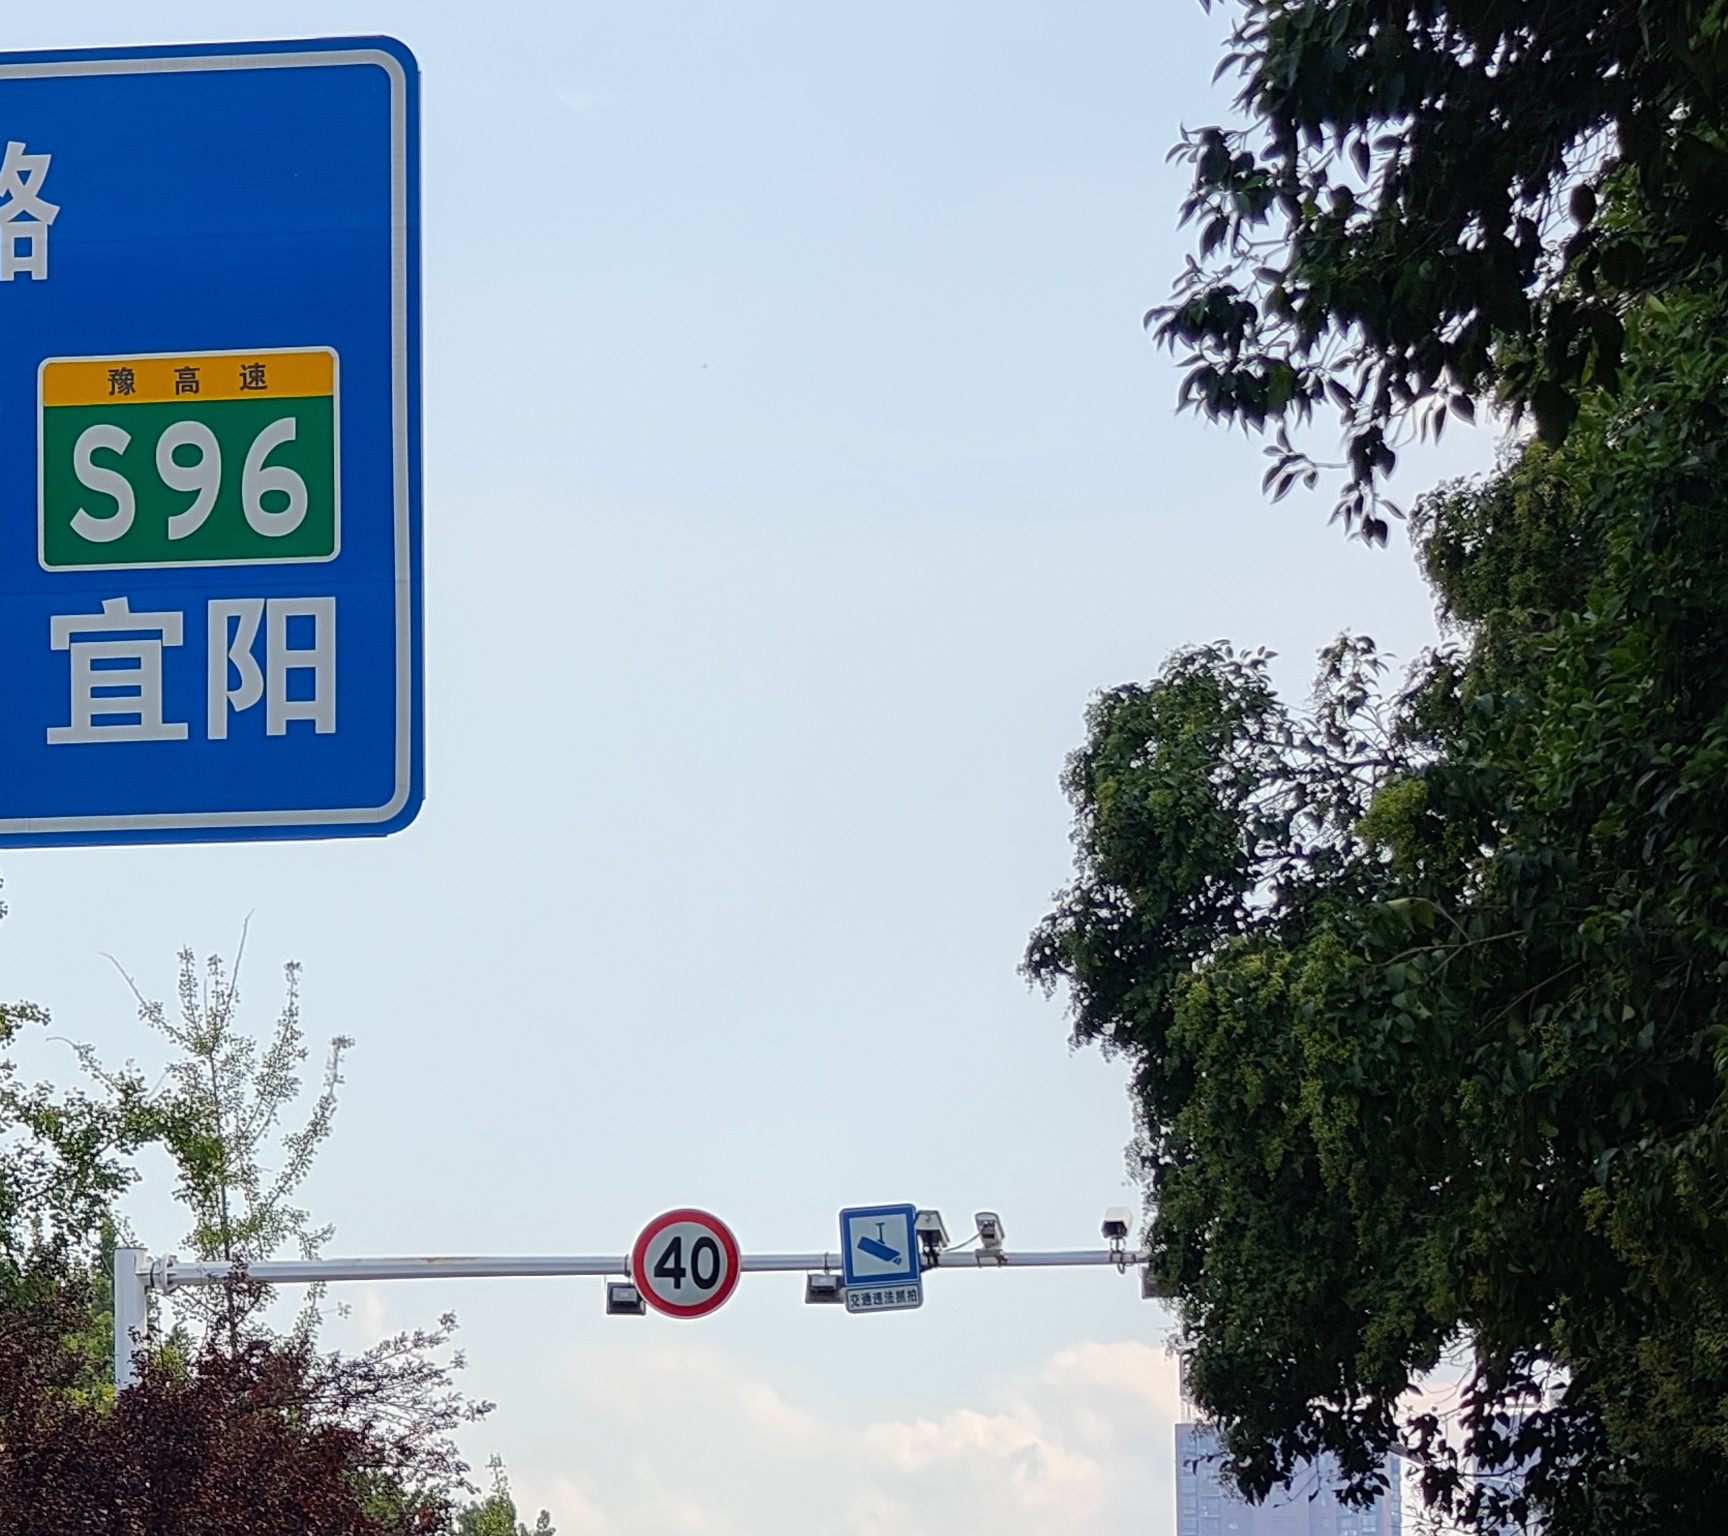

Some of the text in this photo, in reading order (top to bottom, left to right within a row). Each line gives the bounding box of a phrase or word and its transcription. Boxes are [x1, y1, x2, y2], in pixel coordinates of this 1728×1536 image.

[108, 360, 270, 398] 豫高速
[71, 418, 308, 543] S96
[46, 596, 337, 745] 宜阳
[653, 1236, 721, 1290] 40
[849, 1288, 919, 1308] 交通违法抓拍
